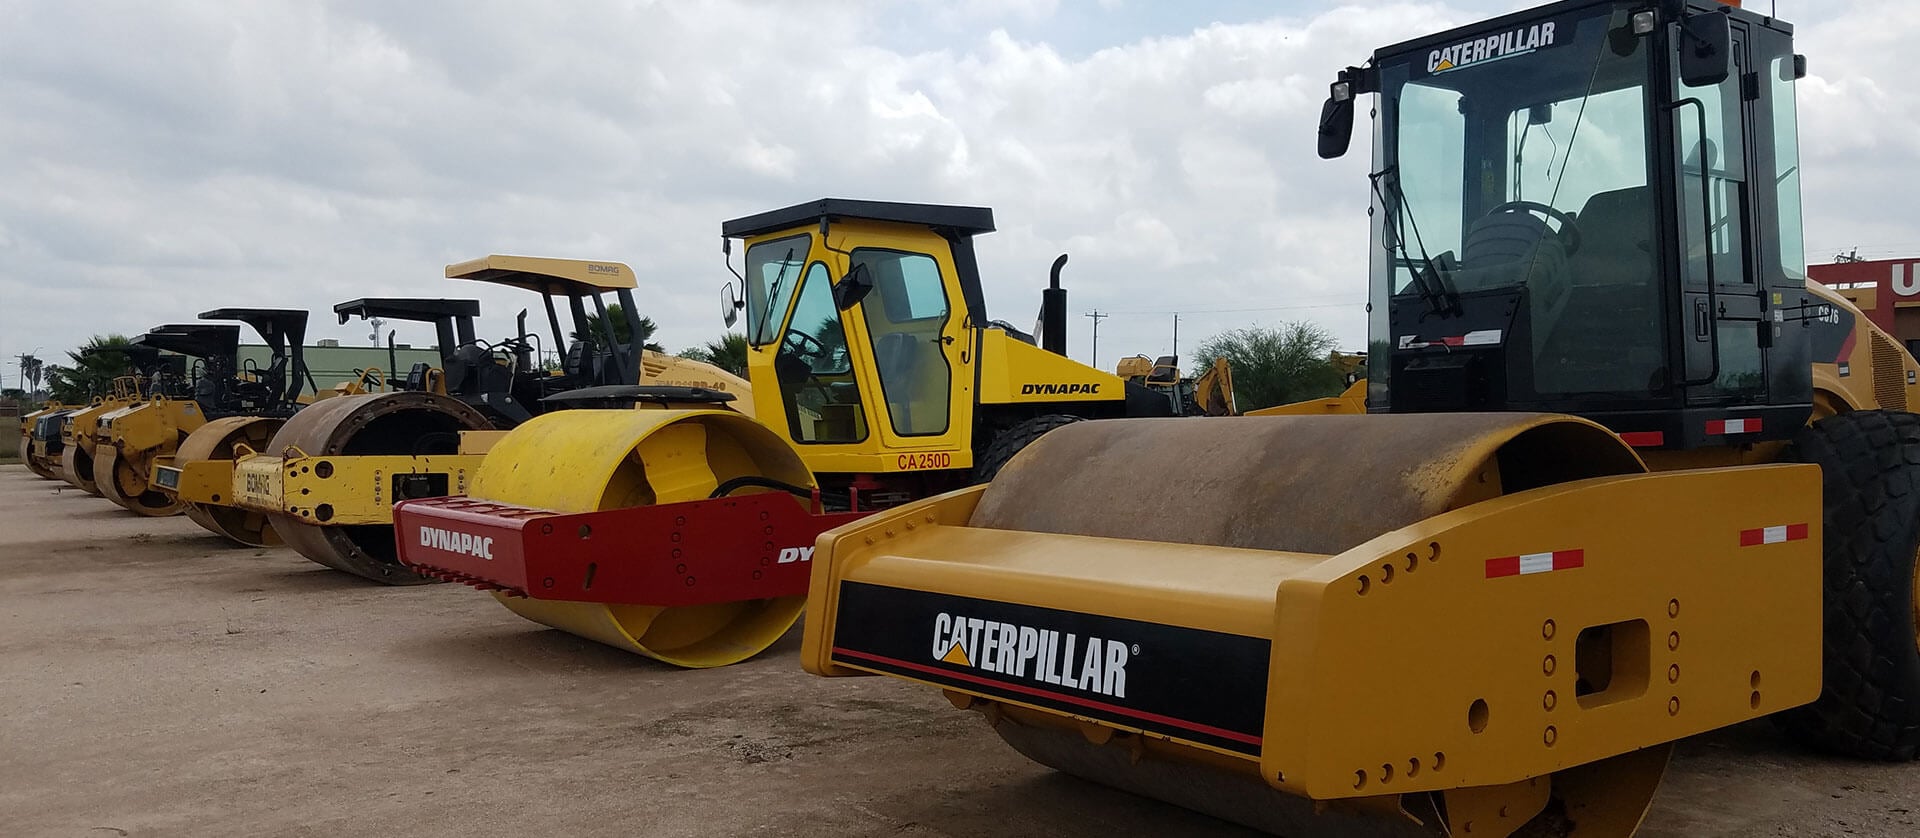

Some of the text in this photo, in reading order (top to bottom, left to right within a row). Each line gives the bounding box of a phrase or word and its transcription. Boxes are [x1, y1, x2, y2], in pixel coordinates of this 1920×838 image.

[1427, 22, 1555, 72] CATERPILLAR
[588, 264, 619, 273] BOMAG
[1021, 383, 1100, 395] DYNAPAC
[420, 526, 493, 560] DYNAPAC
